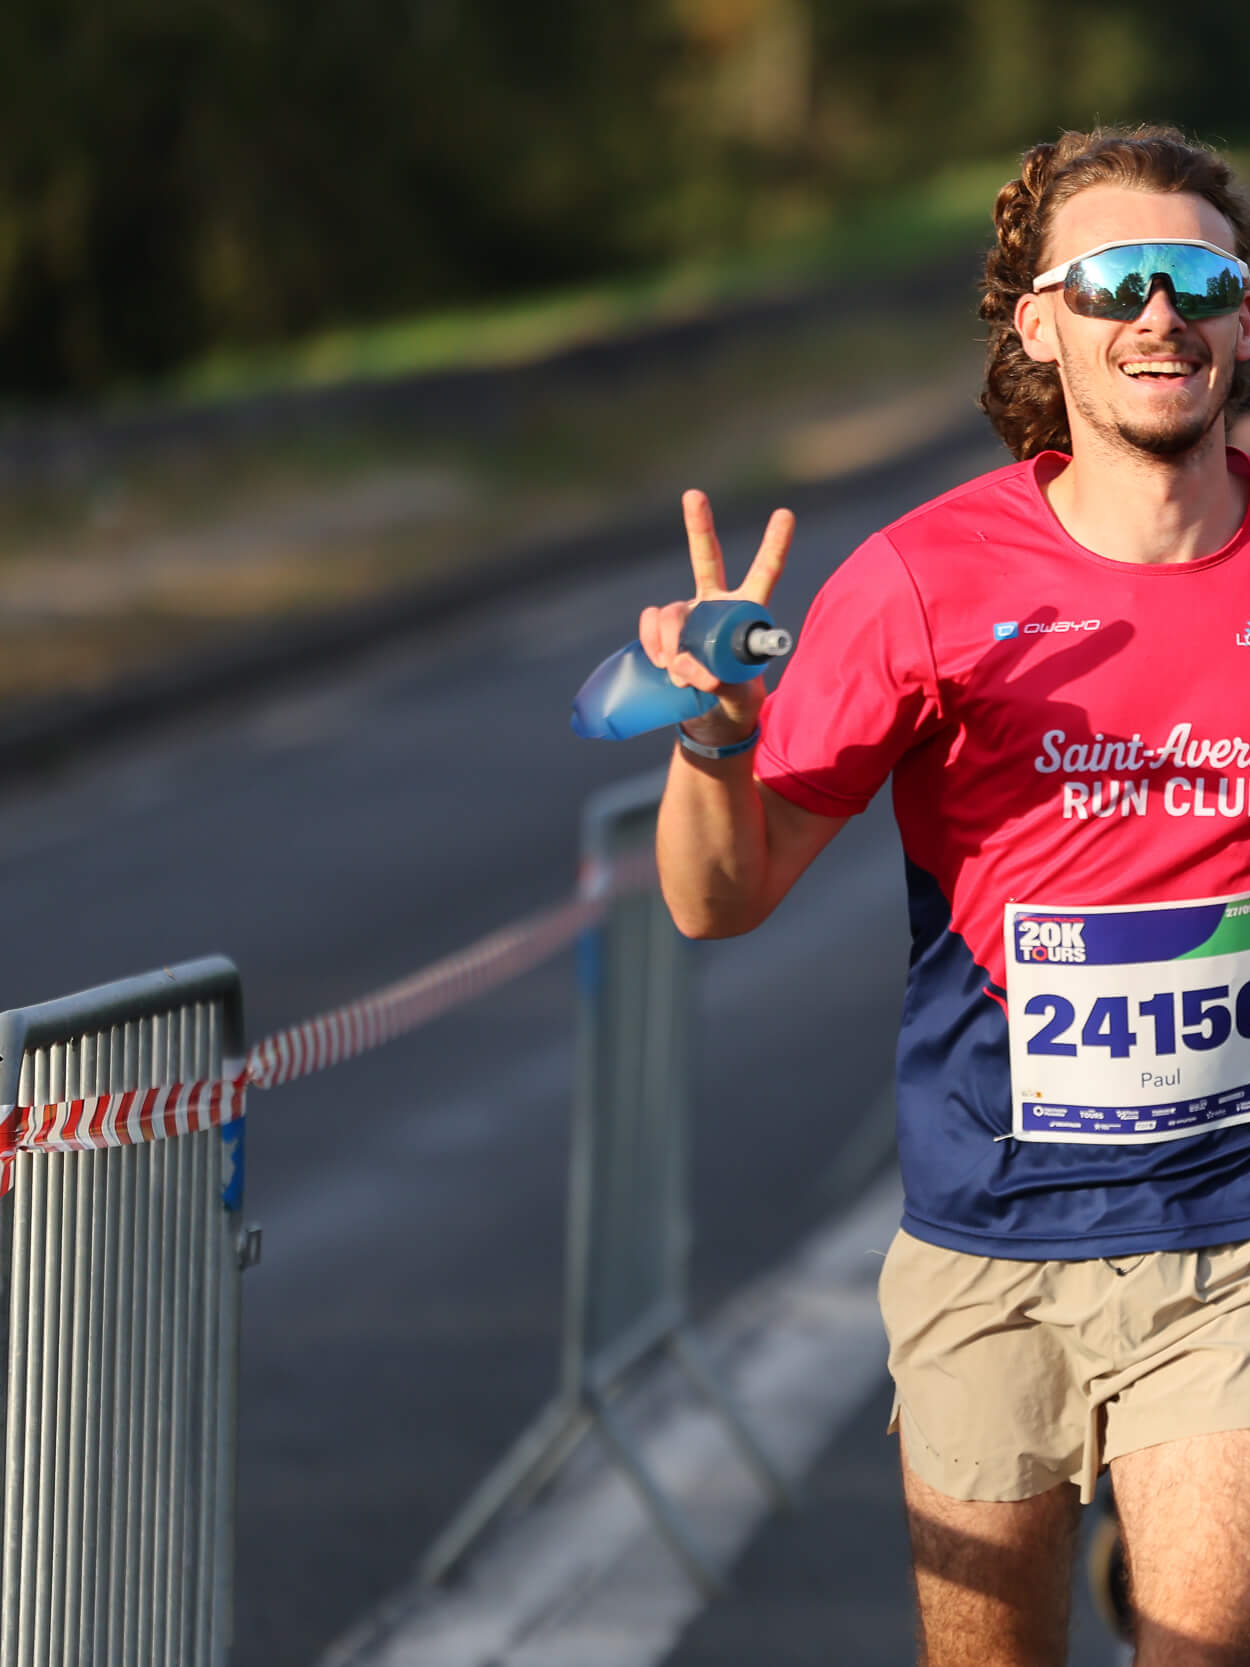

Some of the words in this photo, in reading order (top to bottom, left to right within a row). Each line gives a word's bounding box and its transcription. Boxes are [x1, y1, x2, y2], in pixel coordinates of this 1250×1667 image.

[1063, 778, 1149, 820] RUN
[1018, 921, 1085, 948] 20K
[1020, 946, 1086, 963] TOURS
[1141, 1068, 1181, 1089] Paul
